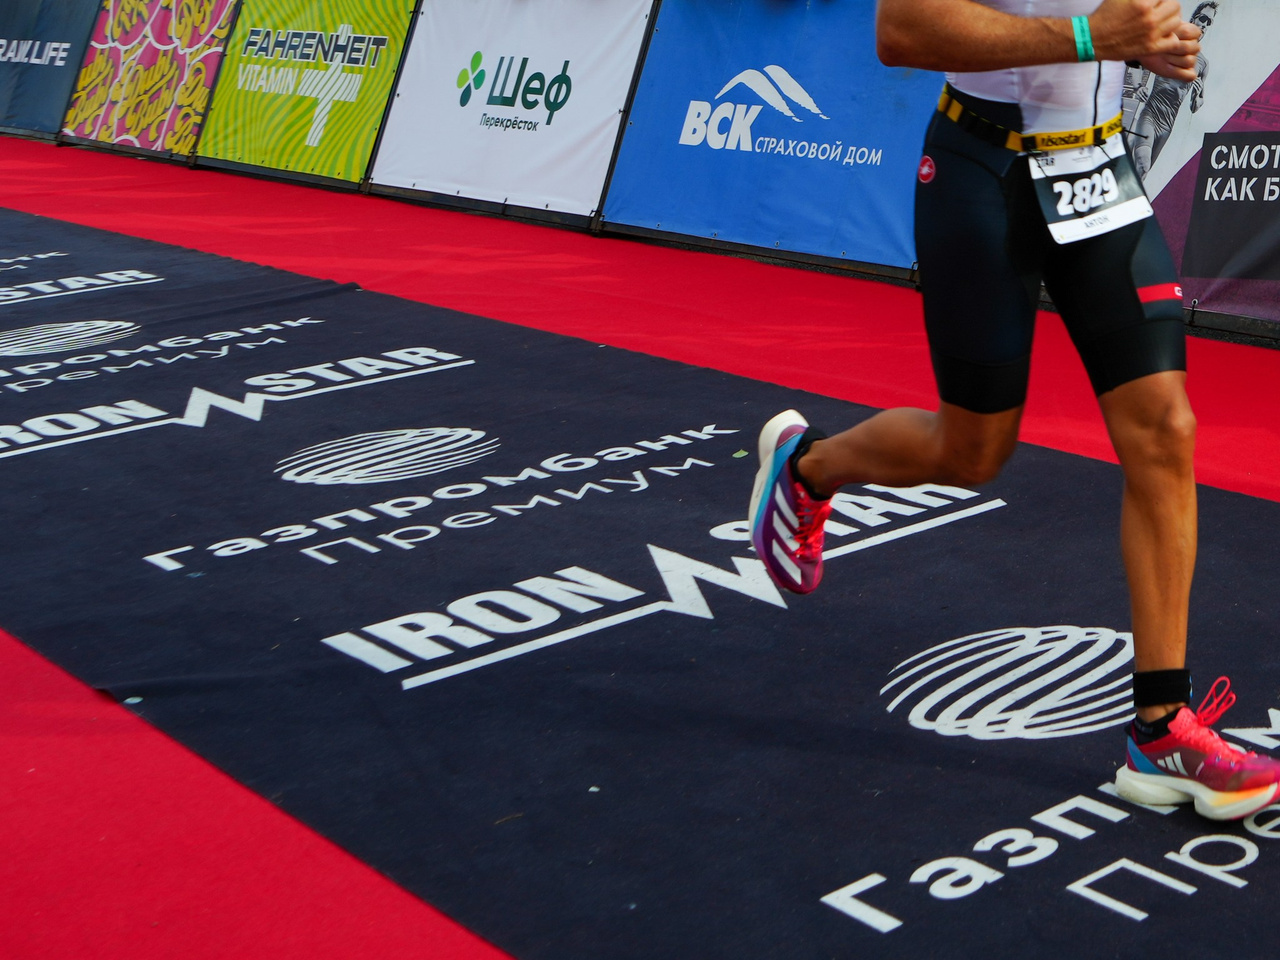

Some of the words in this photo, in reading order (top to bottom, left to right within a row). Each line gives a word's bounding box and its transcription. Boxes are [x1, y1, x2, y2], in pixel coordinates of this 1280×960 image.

[241, 24, 389, 69] FAHRENHEIT
[238, 63, 299, 96] VITAMIN
[486, 56, 572, 125] Шеф
[480, 113, 539, 131] Перекрёсток
[679, 100, 764, 152] ВСК
[755, 137, 843, 162] СТРАХОВОЙ
[842, 147, 883, 166] ДОМ
[1053, 168, 1119, 216] 2829
[1204, 177, 1258, 201] КАК
[0, 316, 326, 377] ромбанк
[0, 337, 287, 393] ремиум
[244, 346, 463, 393] STAR
[143, 424, 740, 571] Газпромбанк
[301, 456, 715, 565] Премиум
[320, 565, 646, 673] IRON
